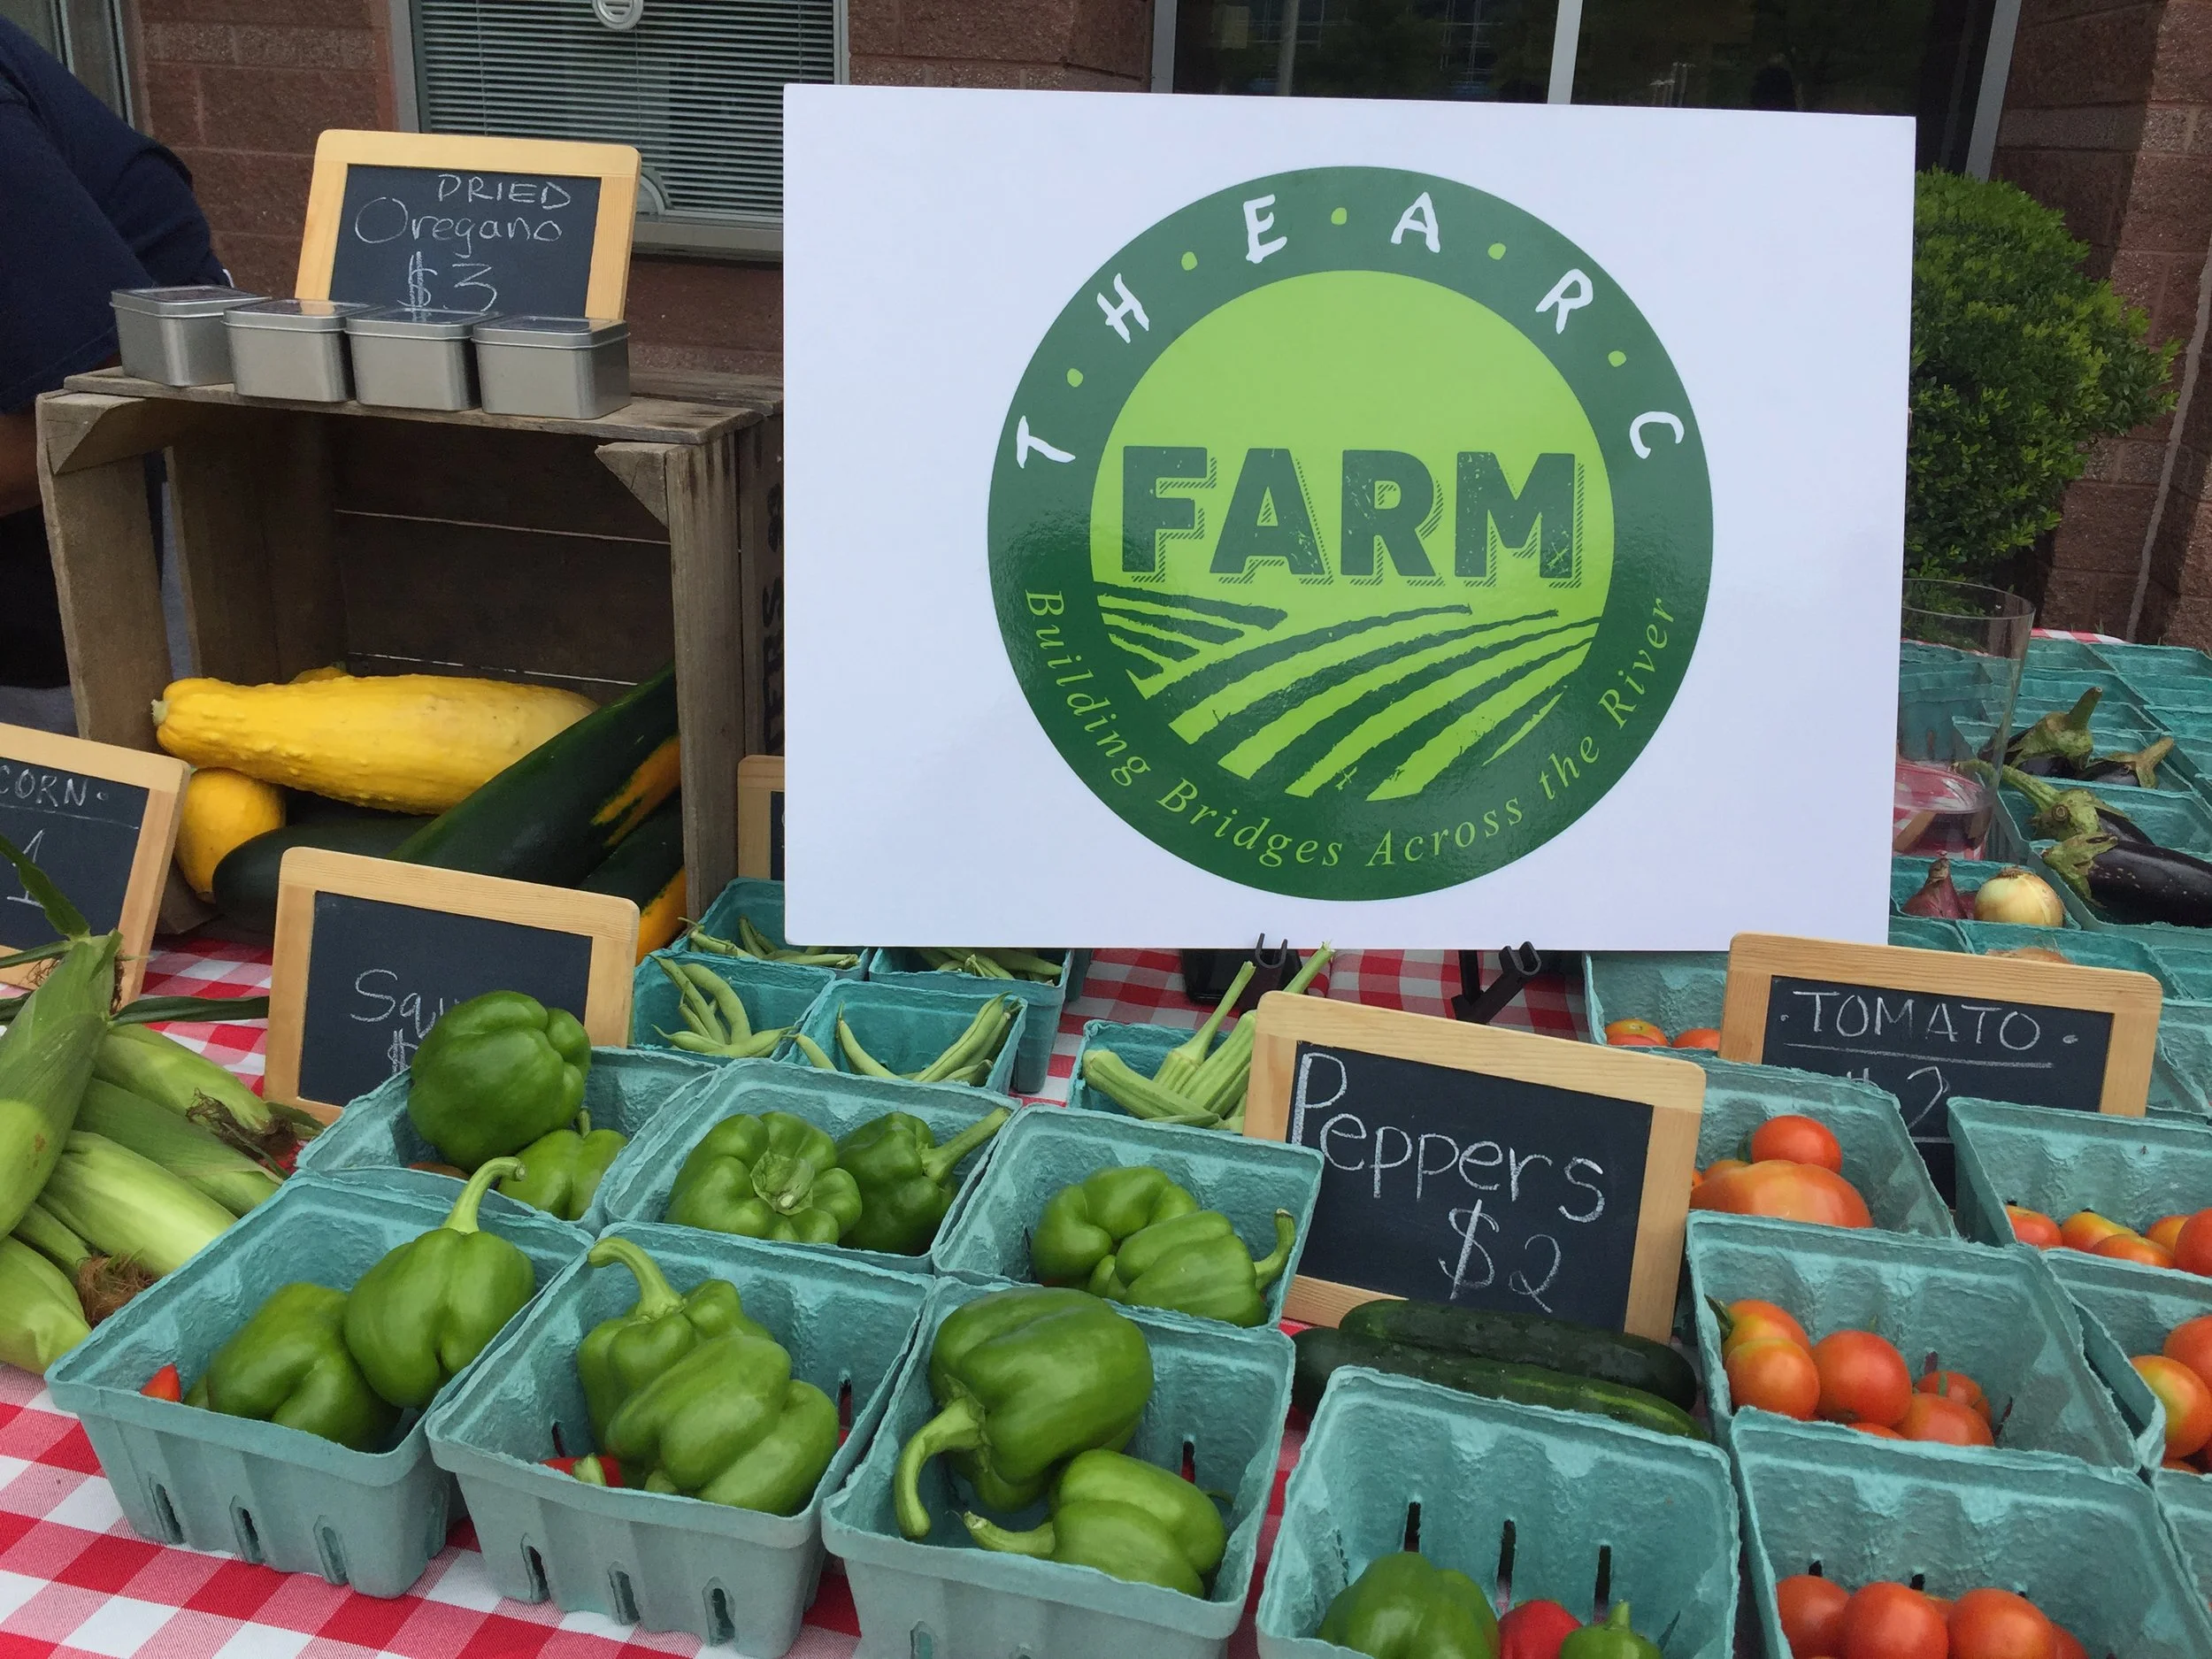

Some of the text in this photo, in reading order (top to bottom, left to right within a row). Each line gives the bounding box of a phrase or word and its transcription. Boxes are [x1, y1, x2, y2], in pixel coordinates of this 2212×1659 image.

[355, 196, 562, 258] Oregano
[438, 173, 571, 210] DRIED
[397, 251, 498, 311] $3
[1122, 445, 1582, 588] FARM
[1025, 589, 1674, 867] Building Bridges Across the River
[1793, 991, 2040, 1051] TOMATO
[1292, 1053, 1606, 1223] Peppers
[1438, 1199, 1579, 1313] $2
